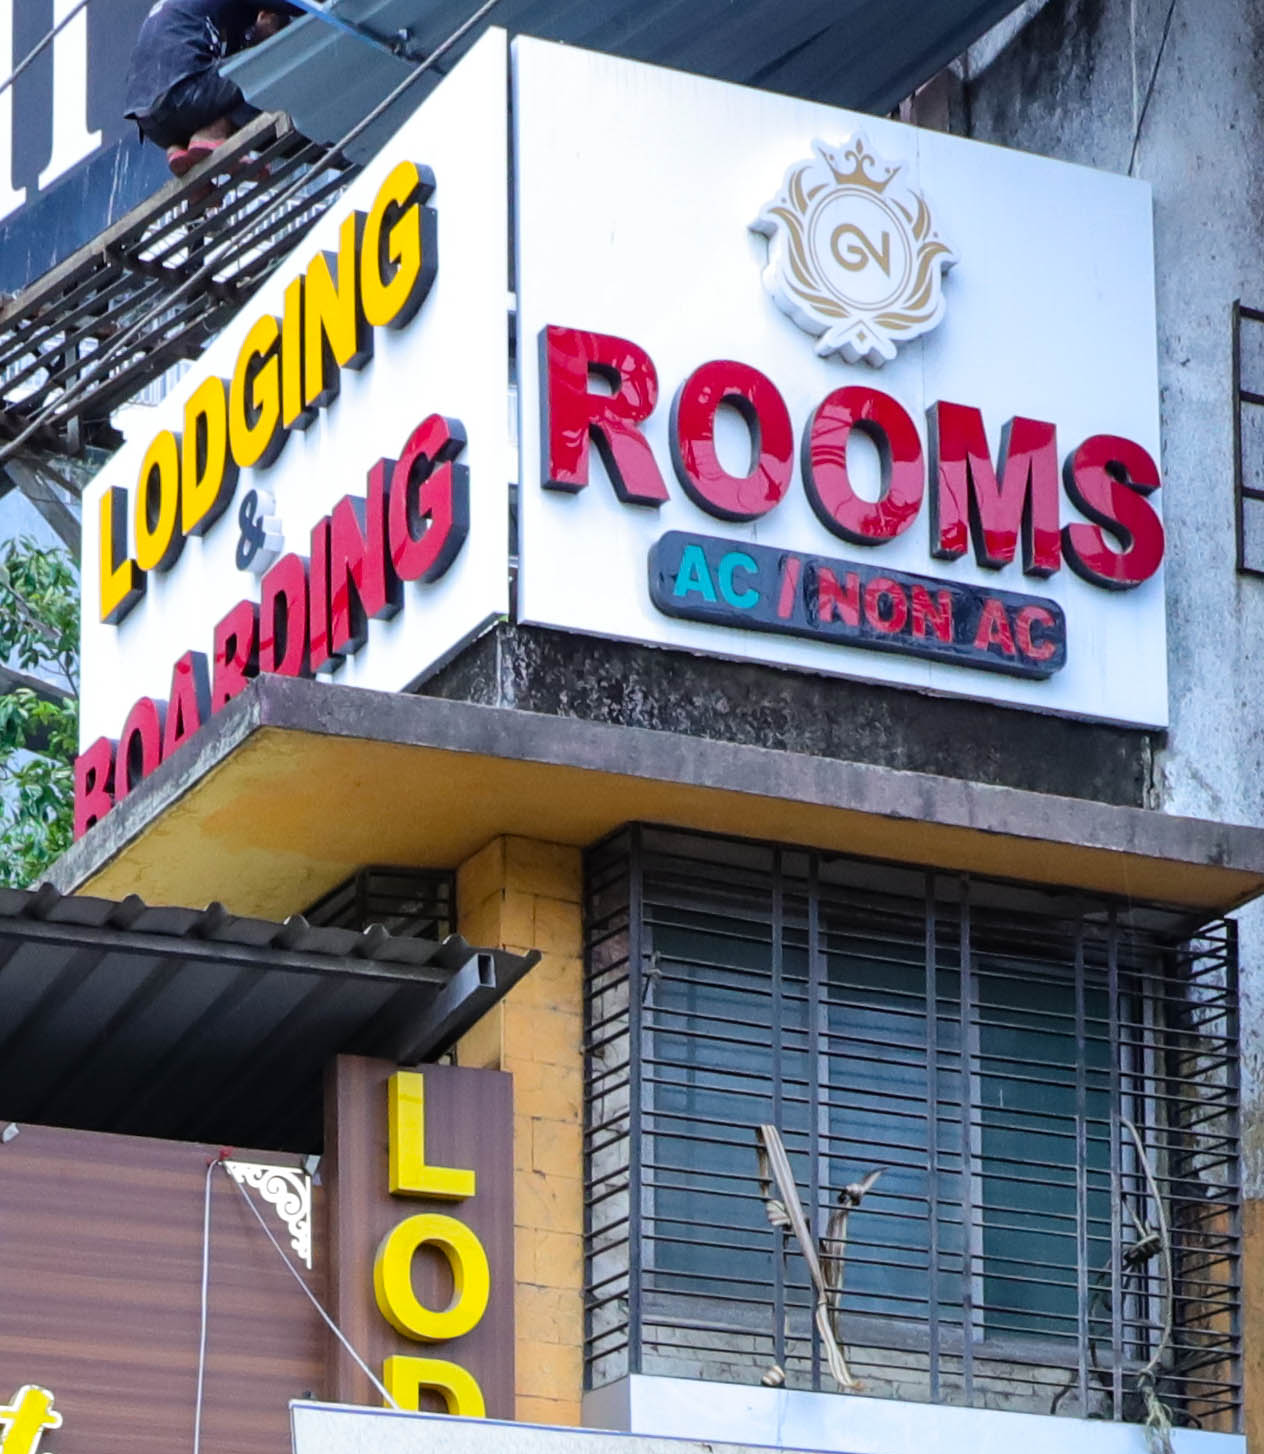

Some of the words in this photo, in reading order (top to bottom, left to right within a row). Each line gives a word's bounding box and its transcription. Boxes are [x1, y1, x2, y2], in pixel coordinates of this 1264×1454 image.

[99, 160, 438, 625] LODGING
[537, 323, 1166, 591] ROOMS
[73, 413, 469, 842] BOARDING
[236, 489, 277, 572] &
[674, 544, 760, 611] AC
[817, 566, 954, 645] NON
[973, 599, 1057, 662] AC
